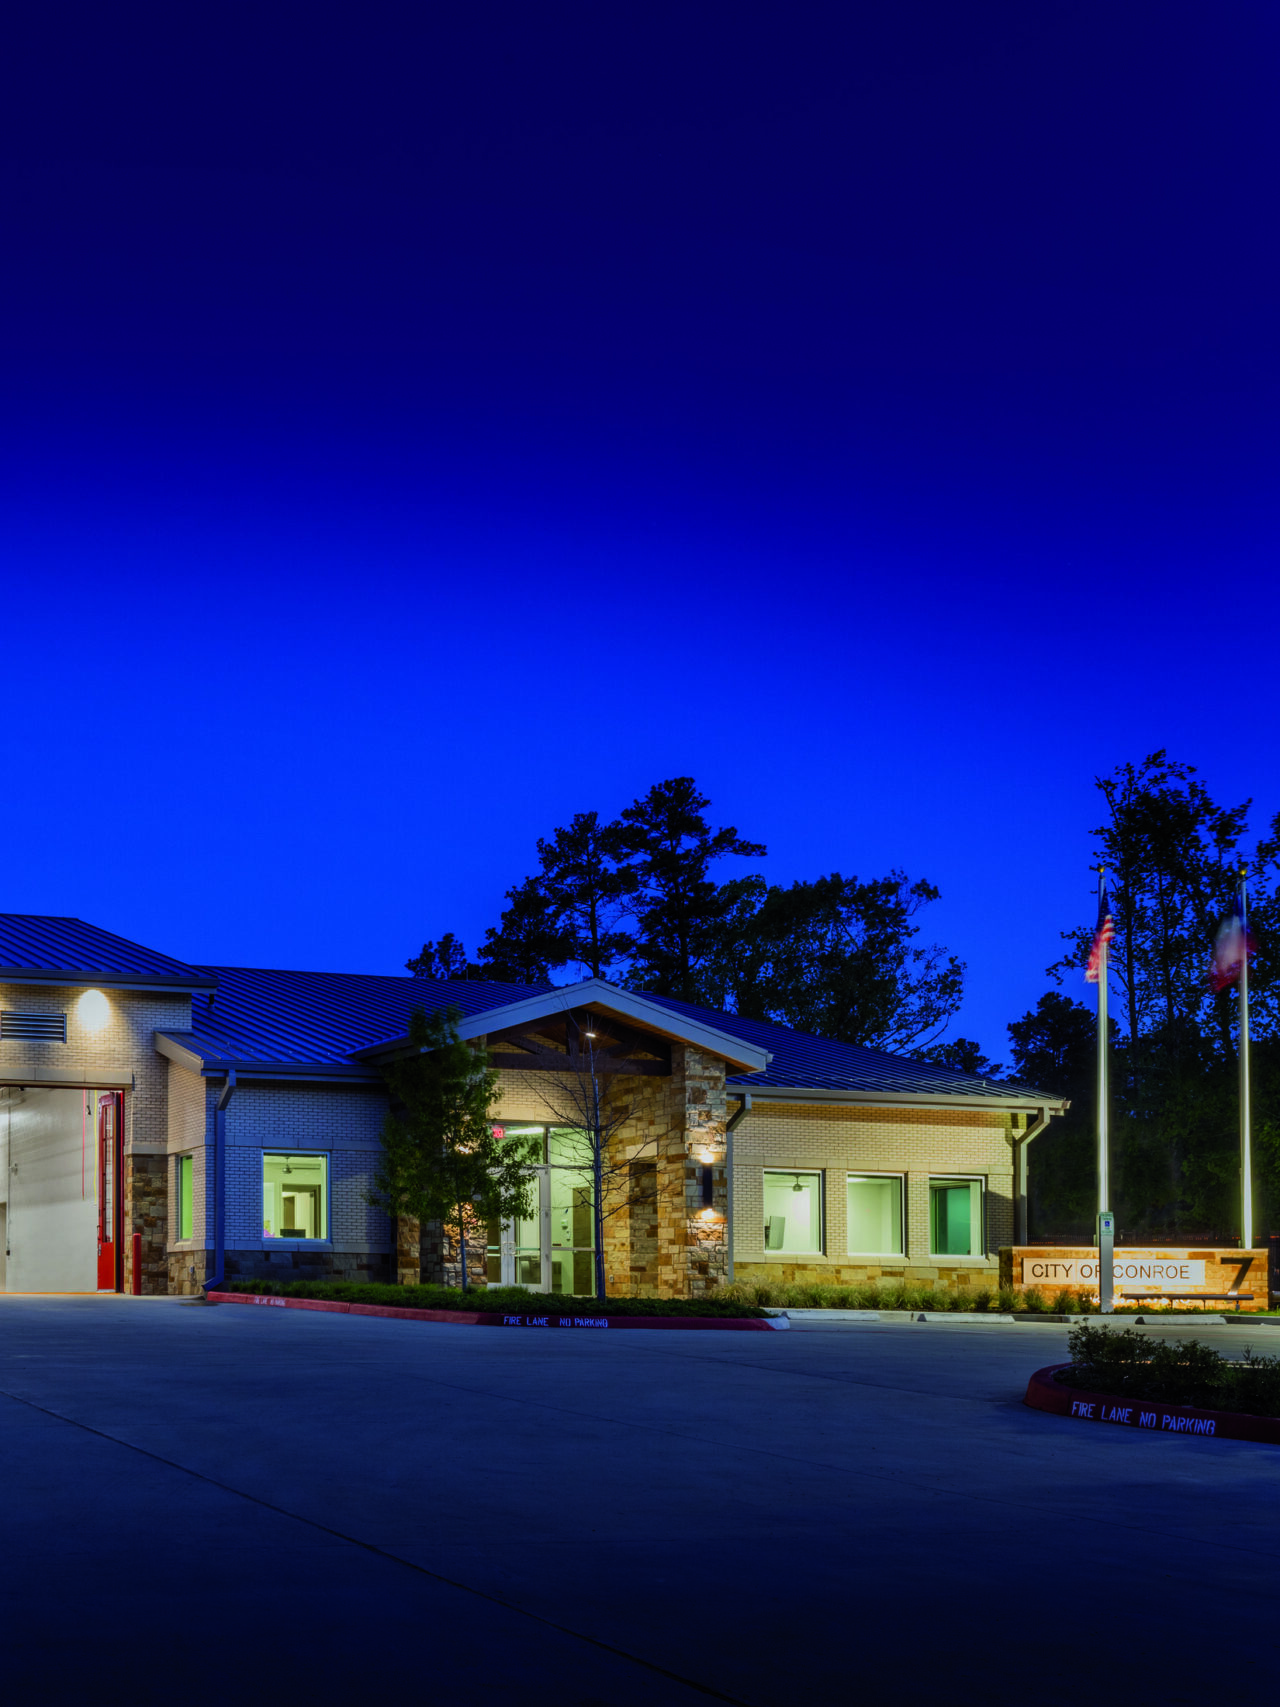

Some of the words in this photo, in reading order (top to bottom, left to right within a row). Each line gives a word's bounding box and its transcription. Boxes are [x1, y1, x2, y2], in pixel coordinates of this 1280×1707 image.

[1031, 1263, 1073, 1278] CITY
[1112, 1264, 1190, 1280] CONROE
[1220, 1256, 1254, 1295] 7
[503, 1316, 522, 1326] FIRE
[526, 1317, 549, 1327] LANE
[559, 1317, 571, 1327] NO
[574, 1317, 608, 1328] PARKING
[1071, 1401, 1096, 1418] FIRE
[1101, 1405, 1133, 1424] LANE
[1139, 1411, 1156, 1428] NO
[1161, 1415, 1216, 1436] PARKING
